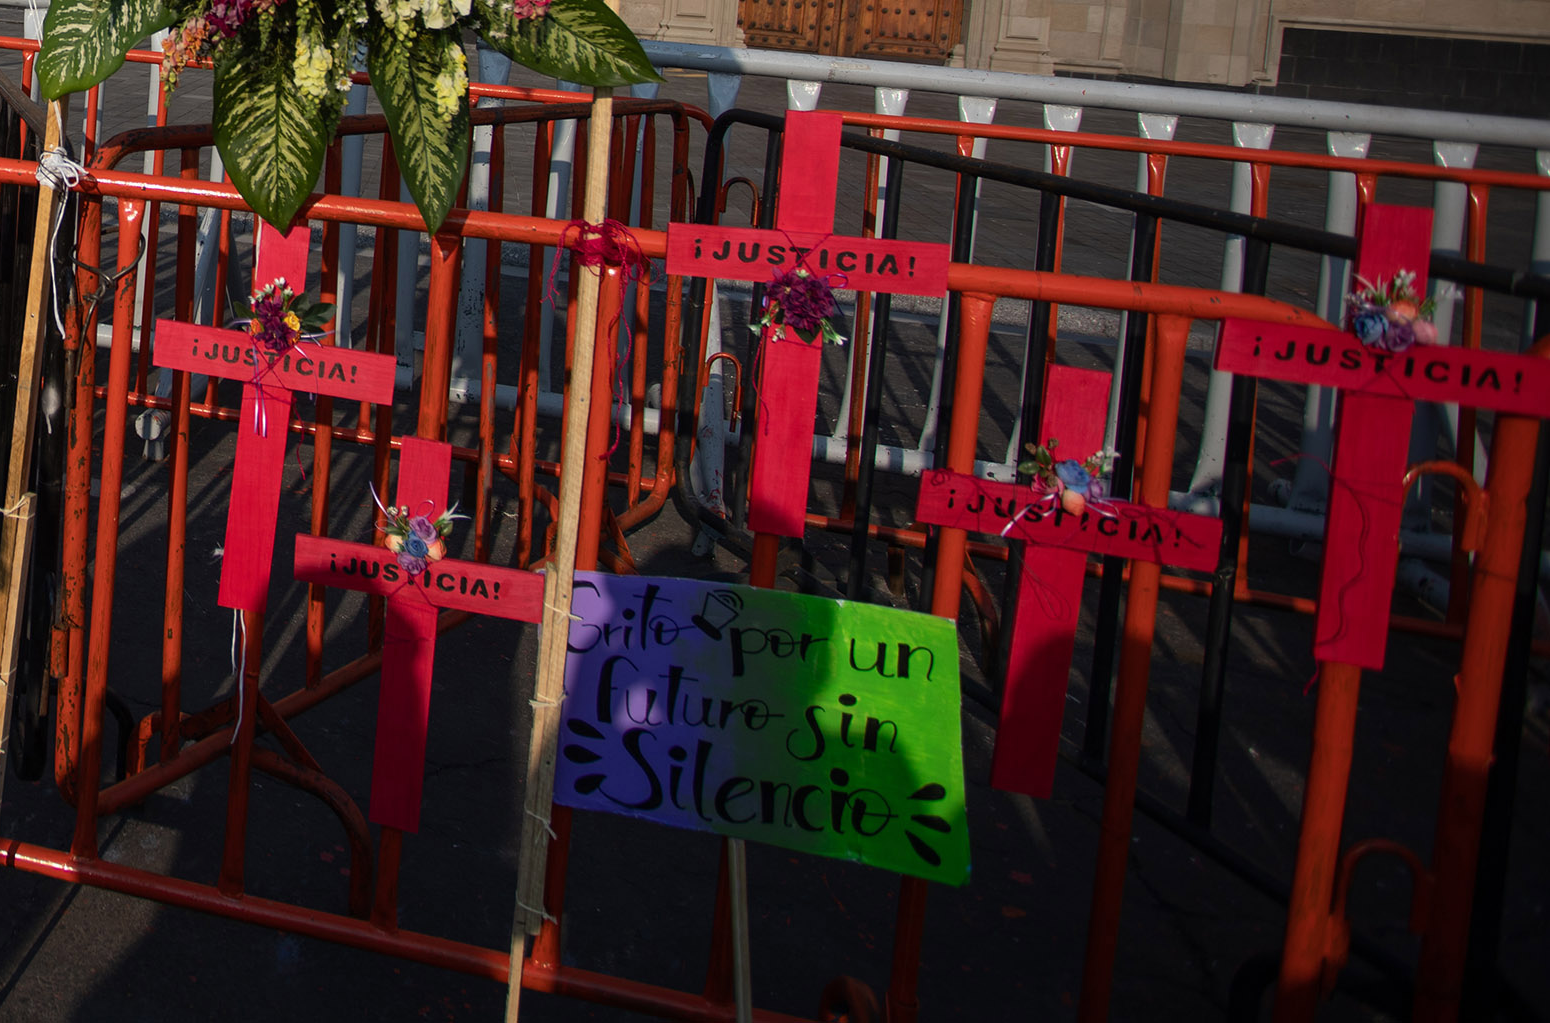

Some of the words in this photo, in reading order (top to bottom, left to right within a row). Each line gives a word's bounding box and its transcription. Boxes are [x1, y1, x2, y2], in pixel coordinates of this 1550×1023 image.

[694, 238, 916, 277] ¡JUSTICIA!
[192, 339, 358, 383] ¡JUSTICIA!
[1253, 336, 1523, 394] ¡JUSTICIA!
[330, 553, 501, 600] ¡JUSICIA!
[730, 625, 830, 677] por
[849, 635, 935, 682] un
[592, 727, 899, 837] Silencio
